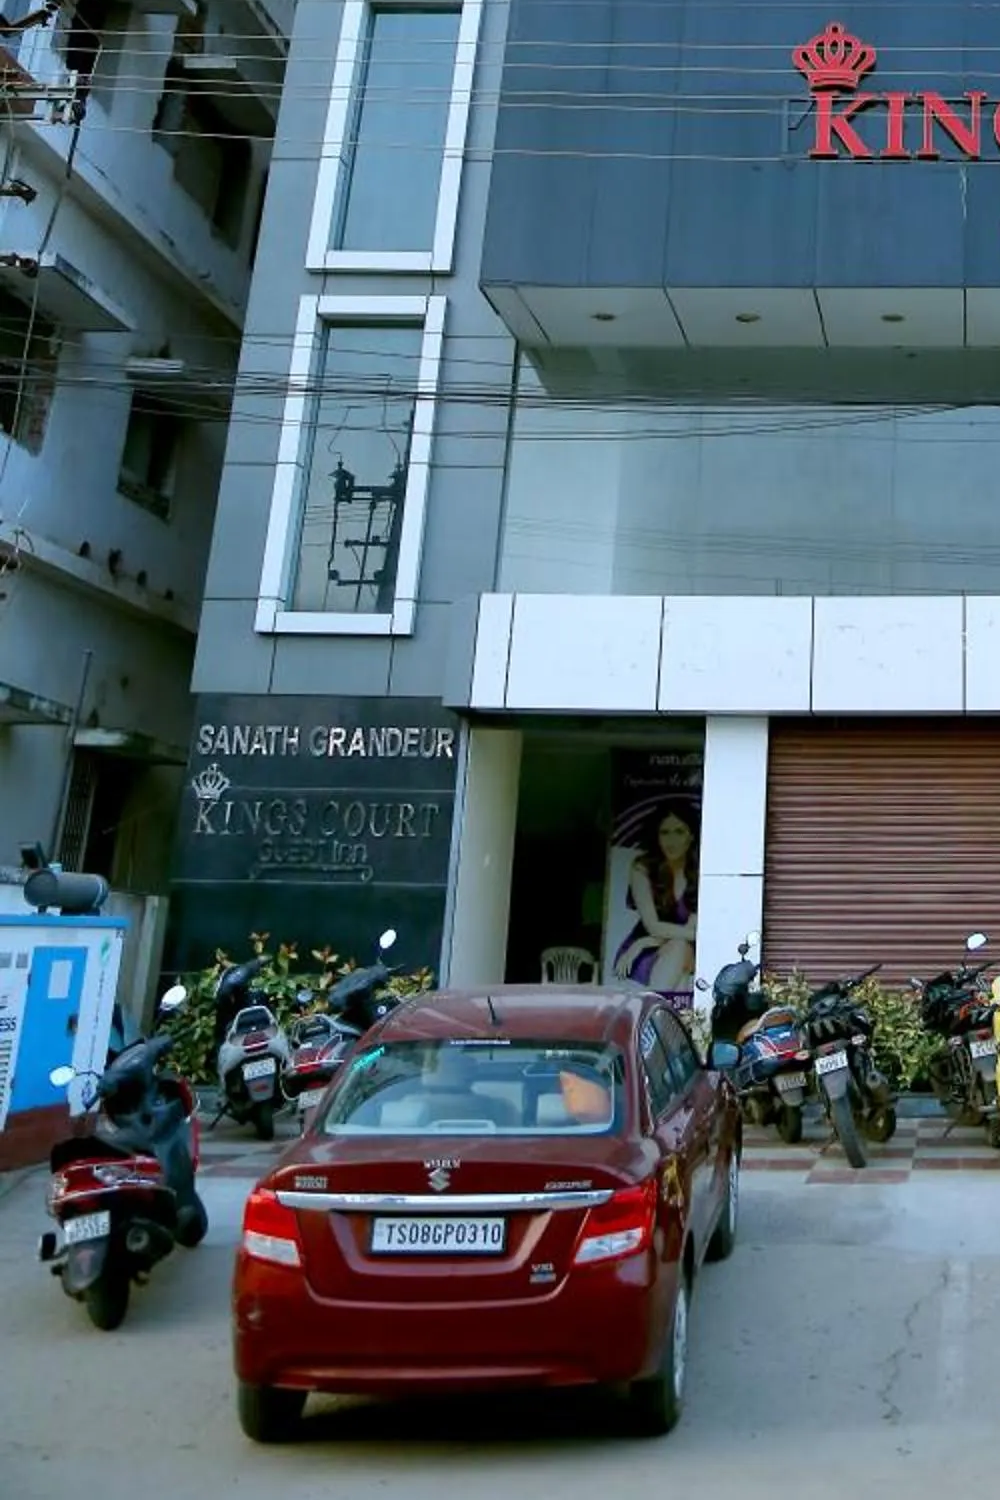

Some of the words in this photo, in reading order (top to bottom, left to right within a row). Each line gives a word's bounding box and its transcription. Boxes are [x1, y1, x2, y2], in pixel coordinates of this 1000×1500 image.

[199, 724, 299, 756] SANATH
[309, 725, 454, 758] GRANDEUR
[193, 799, 307, 836] KINGS
[319, 800, 439, 837] COURT
